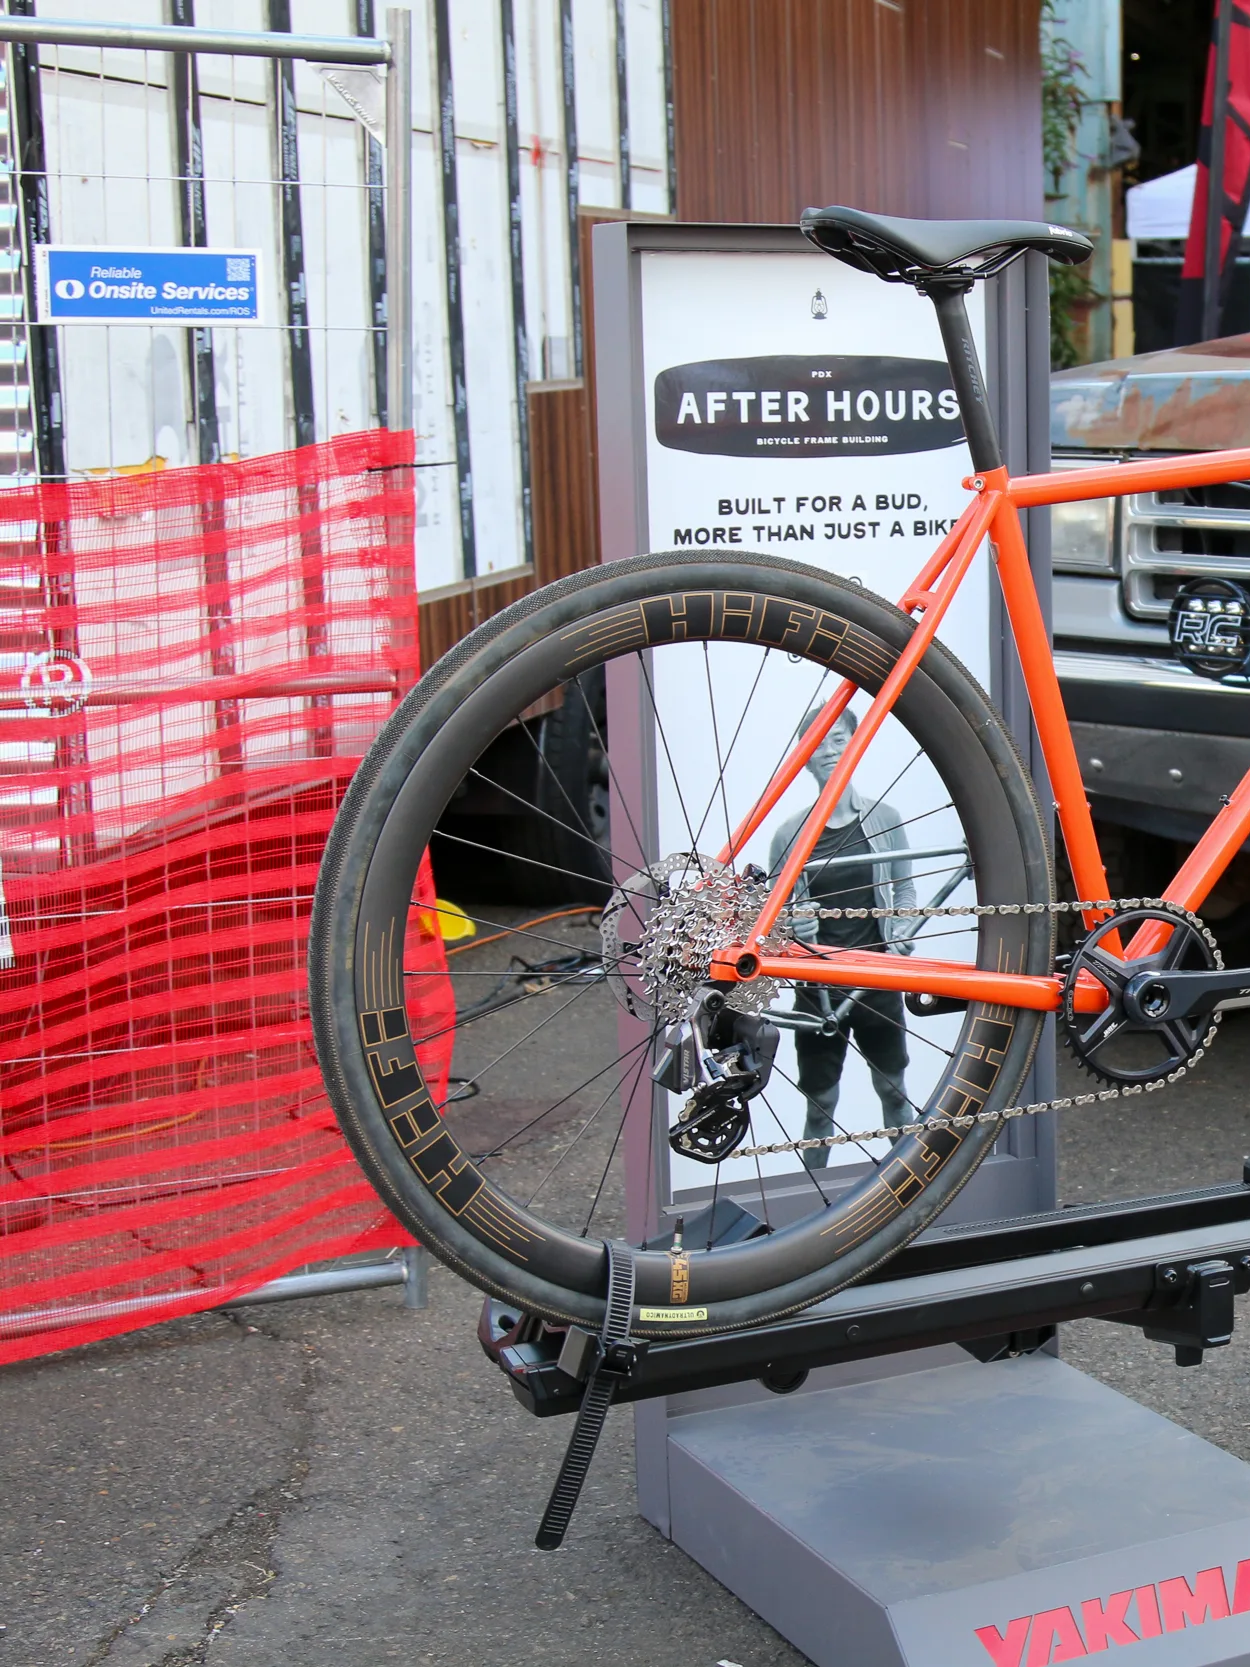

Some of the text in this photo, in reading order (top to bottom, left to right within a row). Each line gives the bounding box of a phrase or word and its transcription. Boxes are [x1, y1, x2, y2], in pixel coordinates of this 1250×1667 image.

[91, 266, 142, 279] Reliable
[89, 281, 250, 301] Onsite Services
[150, 306, 251, 316] UnitedRentals.com/ROS
[811, 370, 833, 378] PDX
[961, 337, 985, 405] RITCHEY
[676, 388, 960, 424] AFTER HOURS
[756, 435, 889, 446] BICYCLE FRAME BUILDING
[717, 493, 928, 516] BUILT FOR A BUD,
[673, 526, 743, 546] MORE
[752, 524, 815, 543] THAN
[823, 521, 881, 540] JUST
[889, 520, 905, 538] A
[639, 592, 850, 663] HiFi
[1174, 611, 1242, 648] RC
[682, 1049, 691, 1084] VISTAR
[645, 1311, 695, 1319] ULTRADYNAMICO
